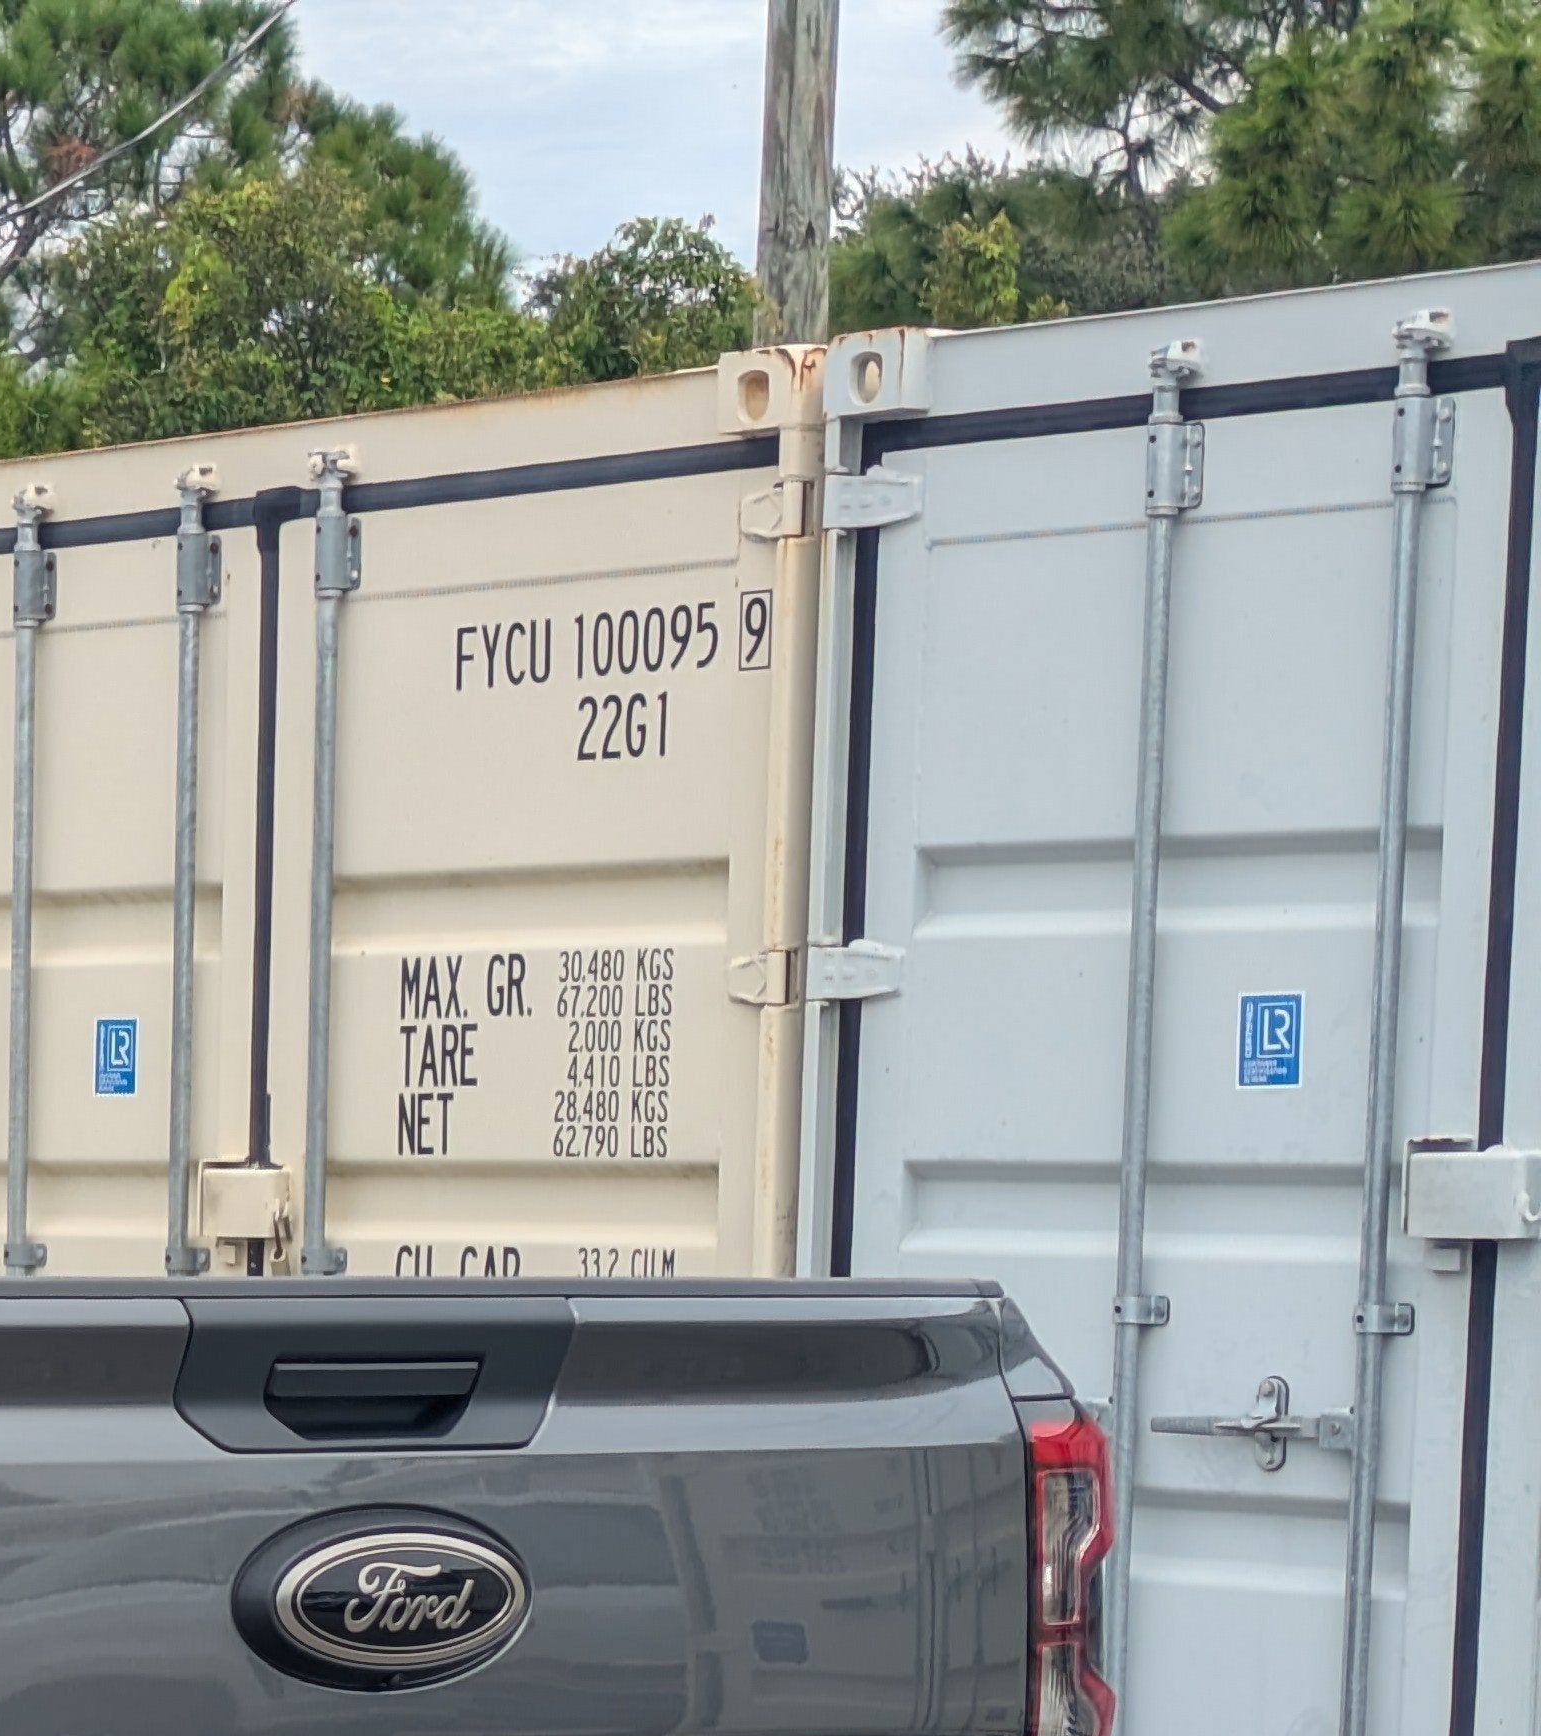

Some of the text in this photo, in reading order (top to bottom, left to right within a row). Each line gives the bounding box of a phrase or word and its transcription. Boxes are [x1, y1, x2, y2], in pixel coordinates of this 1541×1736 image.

[455, 596, 768, 691] FYCU 100095 9
[576, 690, 669, 762] 22G1
[400, 952, 533, 1020] MAX. GR.
[636, 947, 675, 982] KGS
[635, 983, 673, 1017] LBS
[399, 1022, 479, 1089] TARE
[633, 1018, 671, 1052] KGS
[632, 1054, 670, 1088] LBS
[397, 1091, 455, 1158] NET
[631, 1089, 669, 1123] KGS
[631, 1124, 668, 1158] LBS
[343, 1561, 476, 1634] Ford
